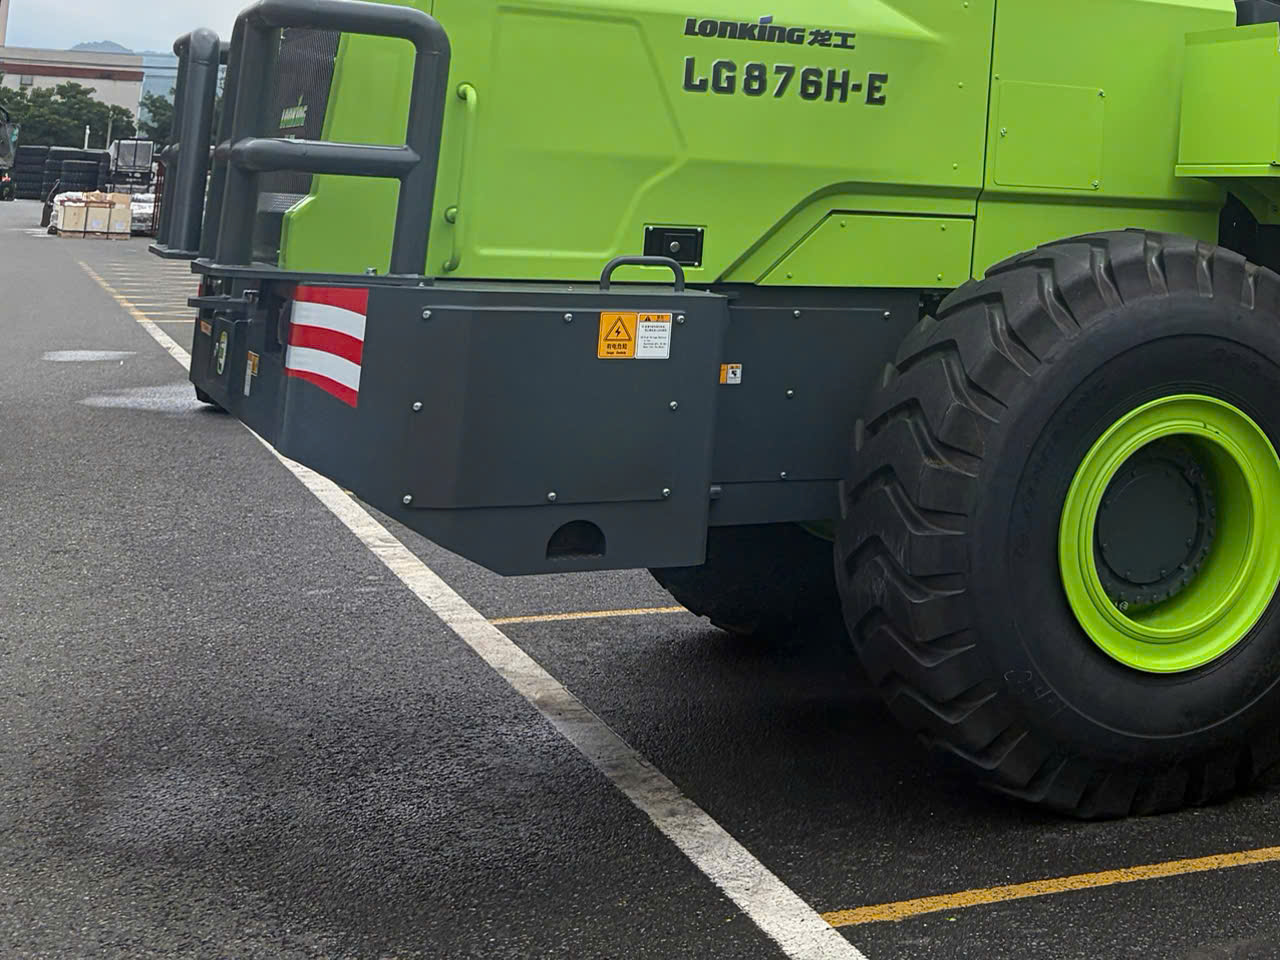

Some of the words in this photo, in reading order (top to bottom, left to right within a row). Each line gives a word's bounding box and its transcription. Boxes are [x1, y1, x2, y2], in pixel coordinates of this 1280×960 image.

[684, 16, 806, 45] LONKING
[807, 29, 856, 50] 龙工
[683, 55, 889, 106] LG876H-E
